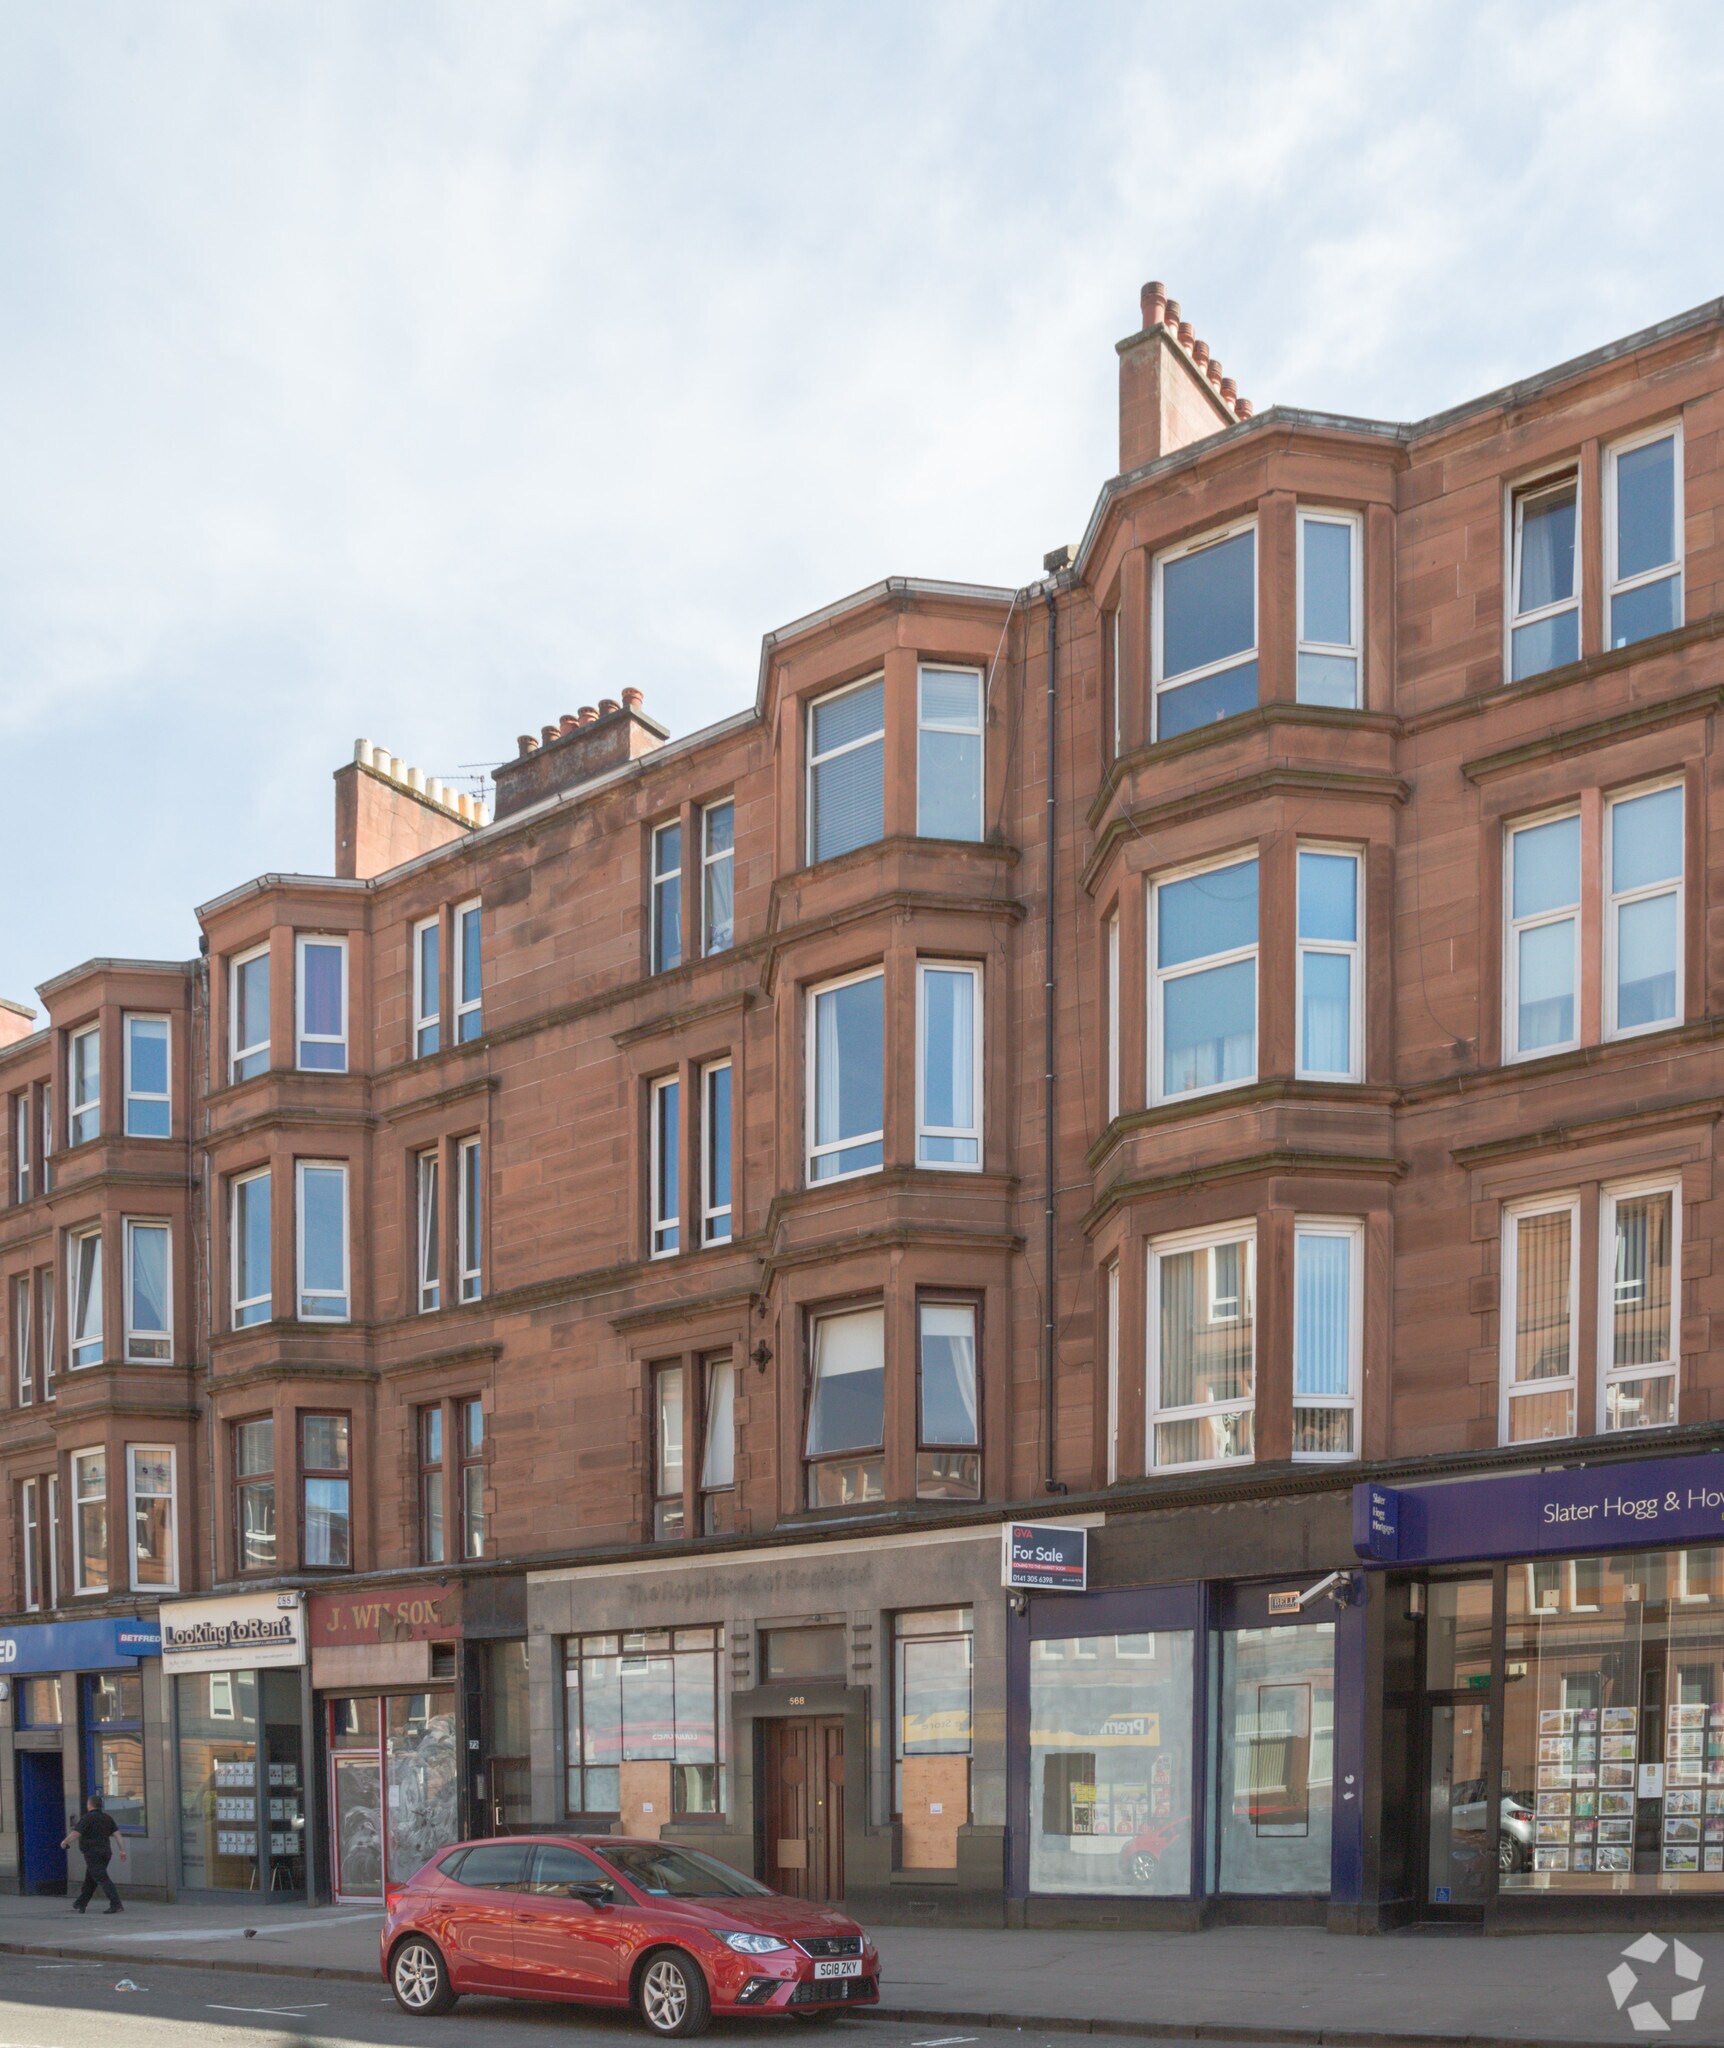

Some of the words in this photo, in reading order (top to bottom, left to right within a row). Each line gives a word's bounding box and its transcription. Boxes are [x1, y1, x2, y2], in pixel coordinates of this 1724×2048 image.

[1543, 1503, 1598, 1523] Slater
[1604, 1496, 1658, 1520] Hogg
[1664, 1491, 1680, 1511] &
[1013, 1528, 1033, 1539] GVA
[1013, 1545, 1033, 1560] For
[1036, 1547, 1063, 1562] Sale
[1013, 1574, 1026, 1582] 0141
[1027, 1575, 1038, 1583] 305
[120, 1633, 161, 1643] BETFRED
[789, 1696, 805, 1705] 568
[820, 1963, 840, 1976] SG18
[841, 1962, 857, 1974] ZKY
